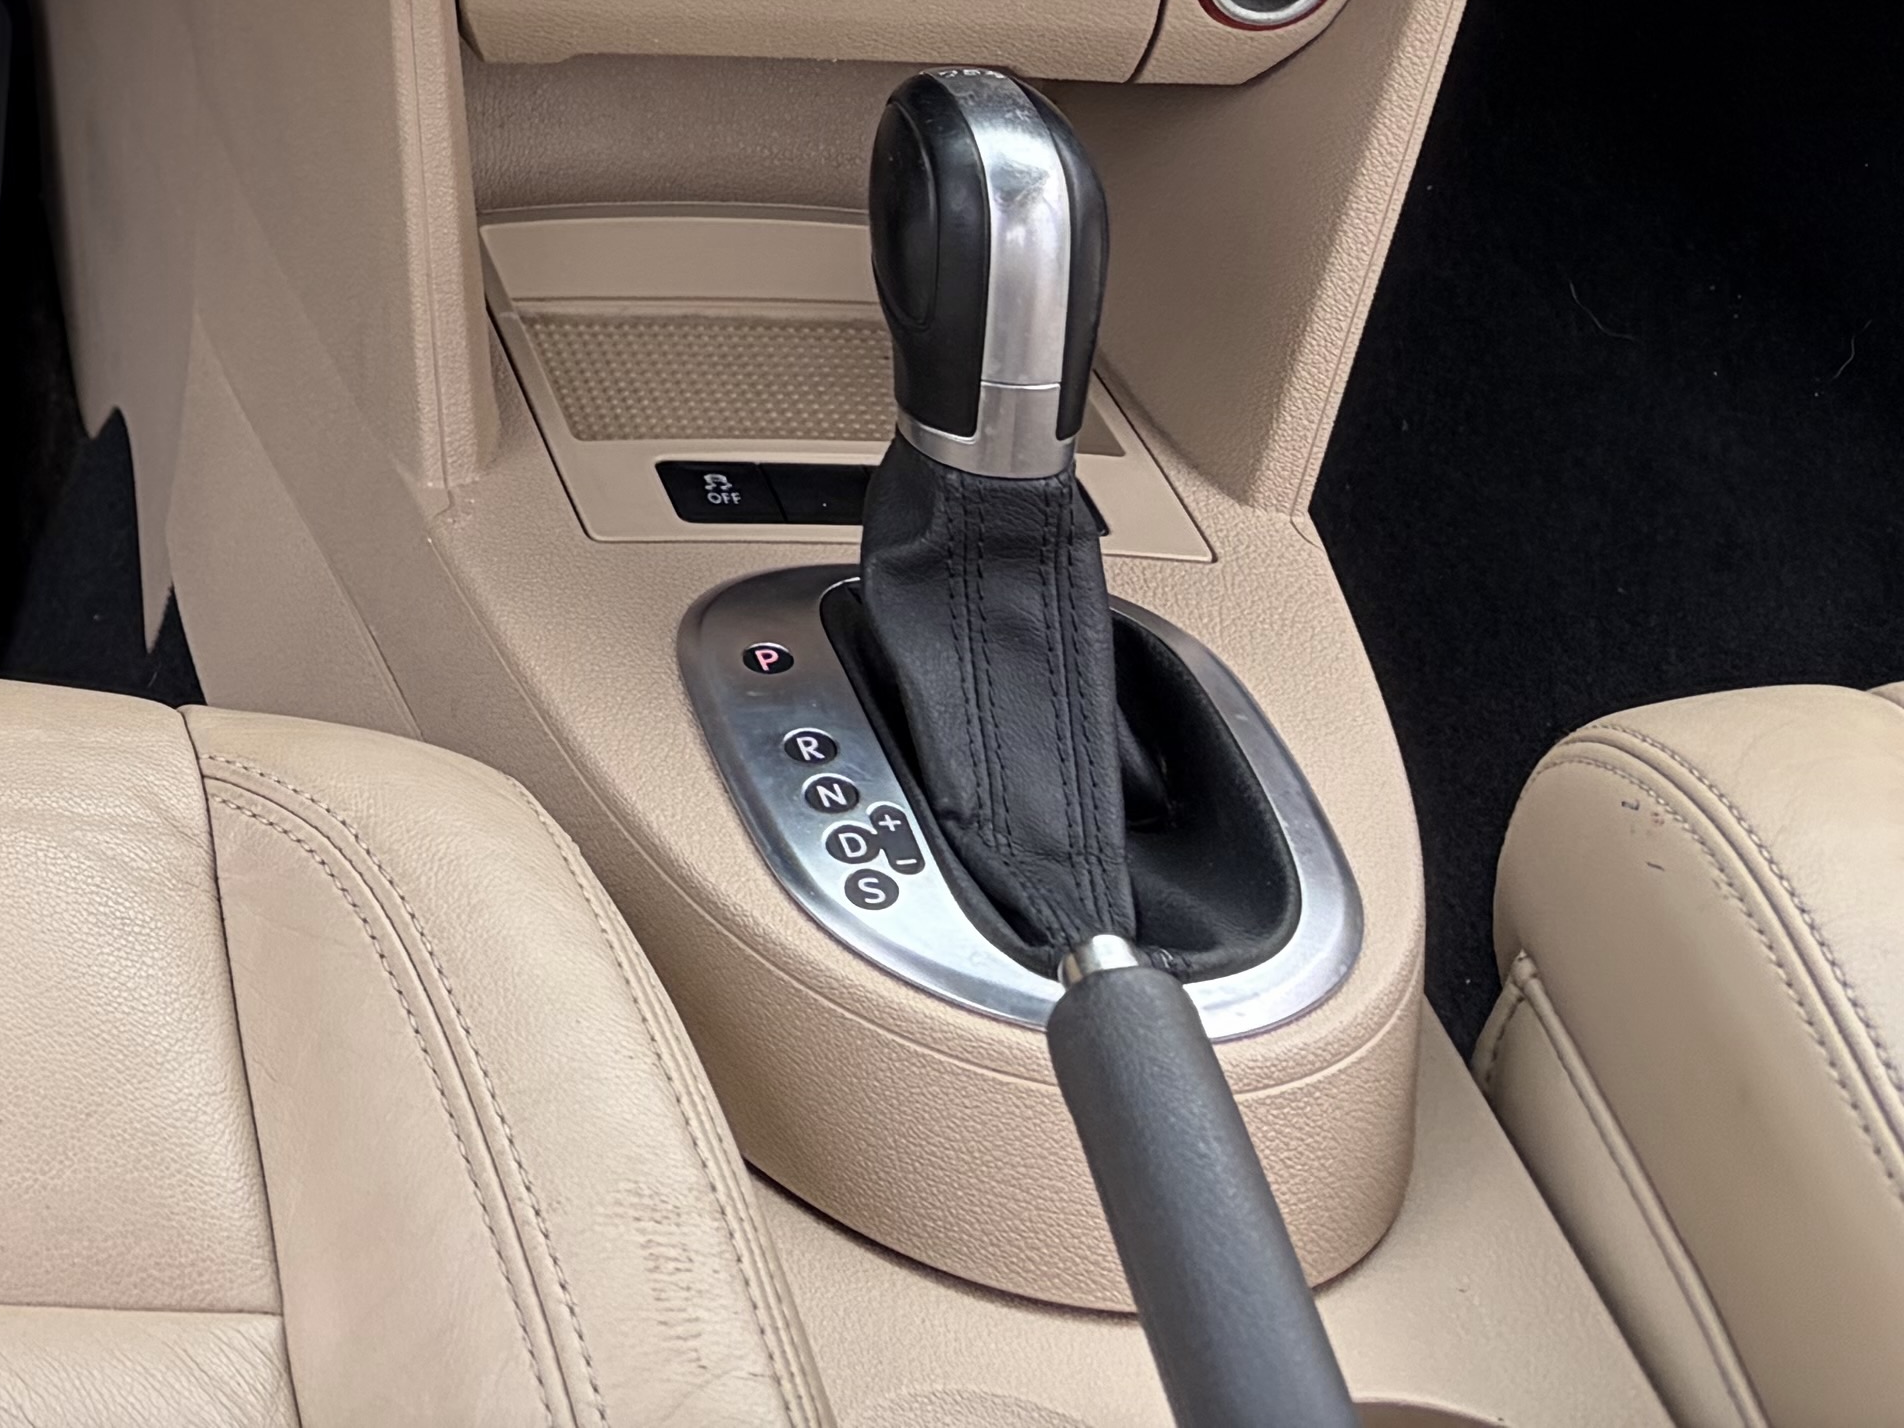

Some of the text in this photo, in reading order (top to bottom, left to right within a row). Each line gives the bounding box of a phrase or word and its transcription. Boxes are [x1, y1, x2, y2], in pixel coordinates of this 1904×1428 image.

[706, 492, 741, 505] OFF
[753, 649, 780, 672] P
[795, 735, 826, 762] R
[815, 782, 848, 808] N
[837, 831, 868, 859] D
[857, 876, 887, 905] S
